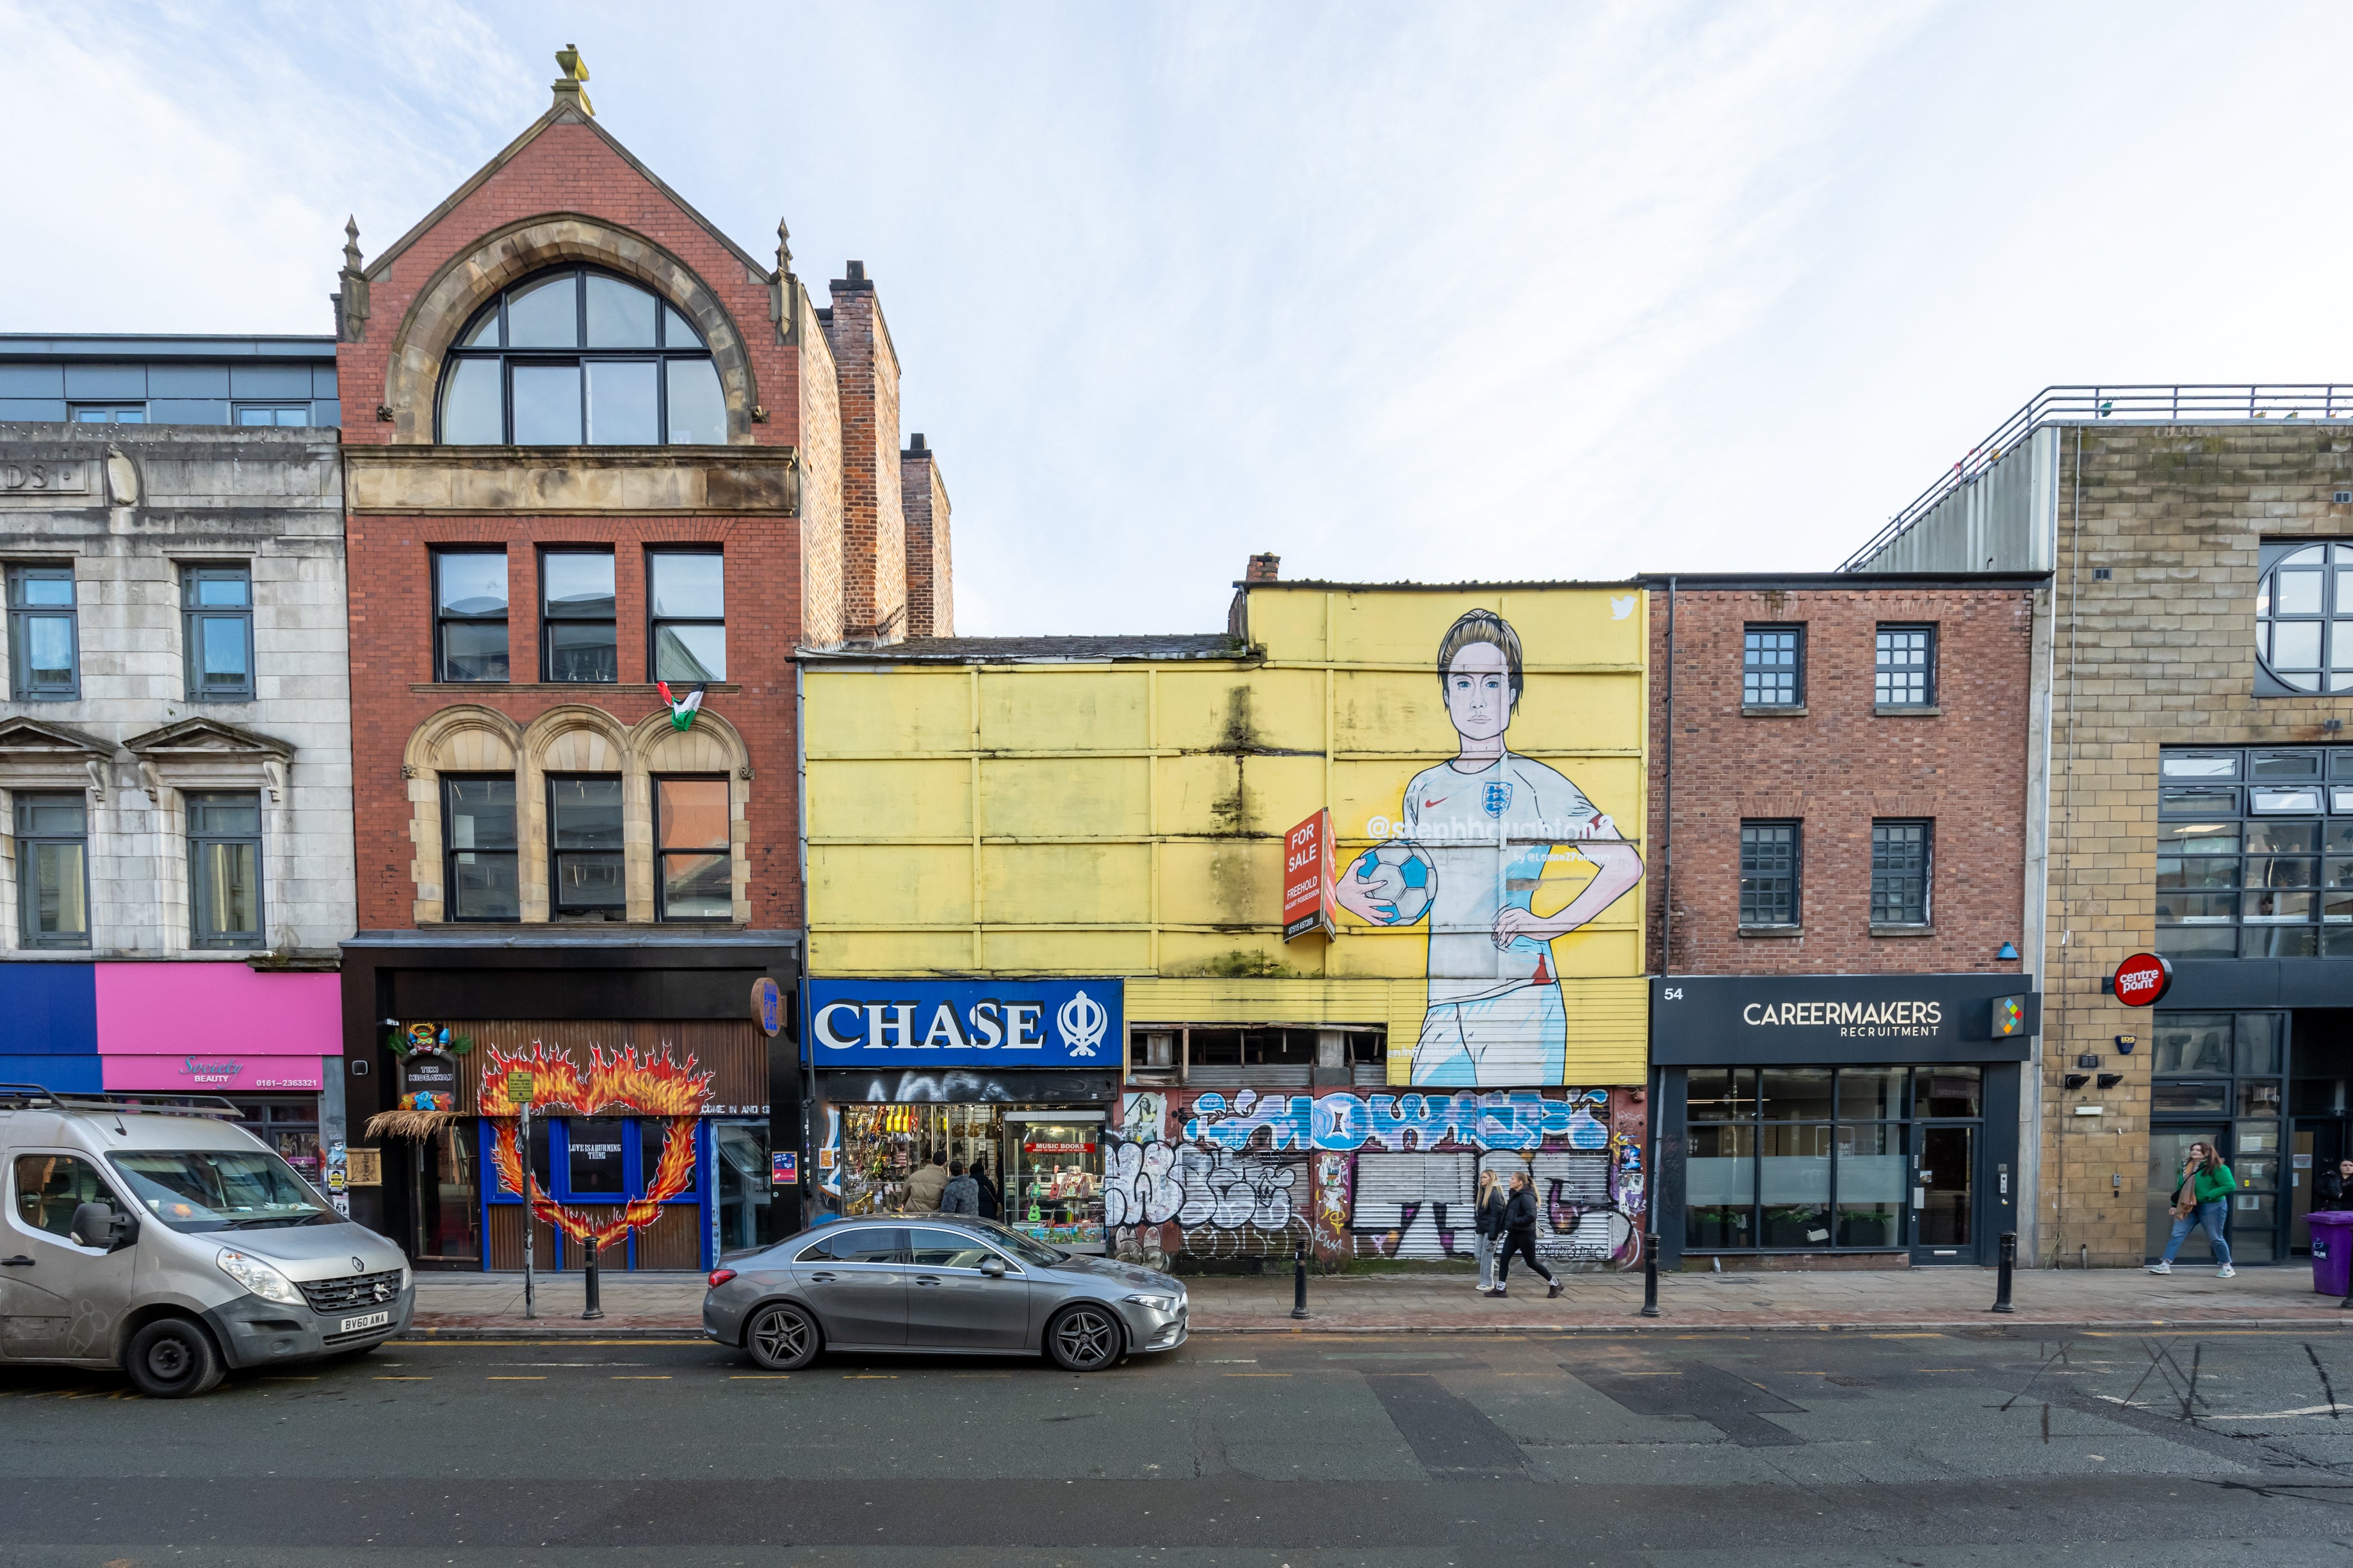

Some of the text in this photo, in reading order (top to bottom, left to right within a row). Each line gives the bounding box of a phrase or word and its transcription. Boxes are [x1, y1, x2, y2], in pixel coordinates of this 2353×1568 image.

[0, 465, 48, 488] DS
[1292, 823, 1314, 850] FOR
[1289, 843, 1317, 873] SALE
[1514, 851, 1612, 864] by @LouiseZPomeroy
[1287, 875, 1317, 901] FREEHOLD
[1285, 898, 1298, 910] VACANT
[1297, 888, 1320, 905] POSSESSION
[1289, 924, 1299, 935] 07515
[2119, 969, 2159, 984] centre
[1664, 988, 1684, 1000] 54
[2122, 978, 2154, 994] point
[1743, 1001, 1942, 1026] CAREERMAKERS
[814, 999, 1046, 1049] CHASE
[1841, 1026, 1939, 1037] RECRUITMENT
[179, 1056, 243, 1089] Society
[701, 1104, 725, 1114] COME
[729, 1104, 737, 1114] IN
[741, 1105, 758, 1114] AND
[568, 1144, 584, 1152] LOVE
[585, 1144, 591, 1152] IS
[594, 1144, 621, 1152] BURNING
[345, 1313, 385, 1330] BV60 AWA
